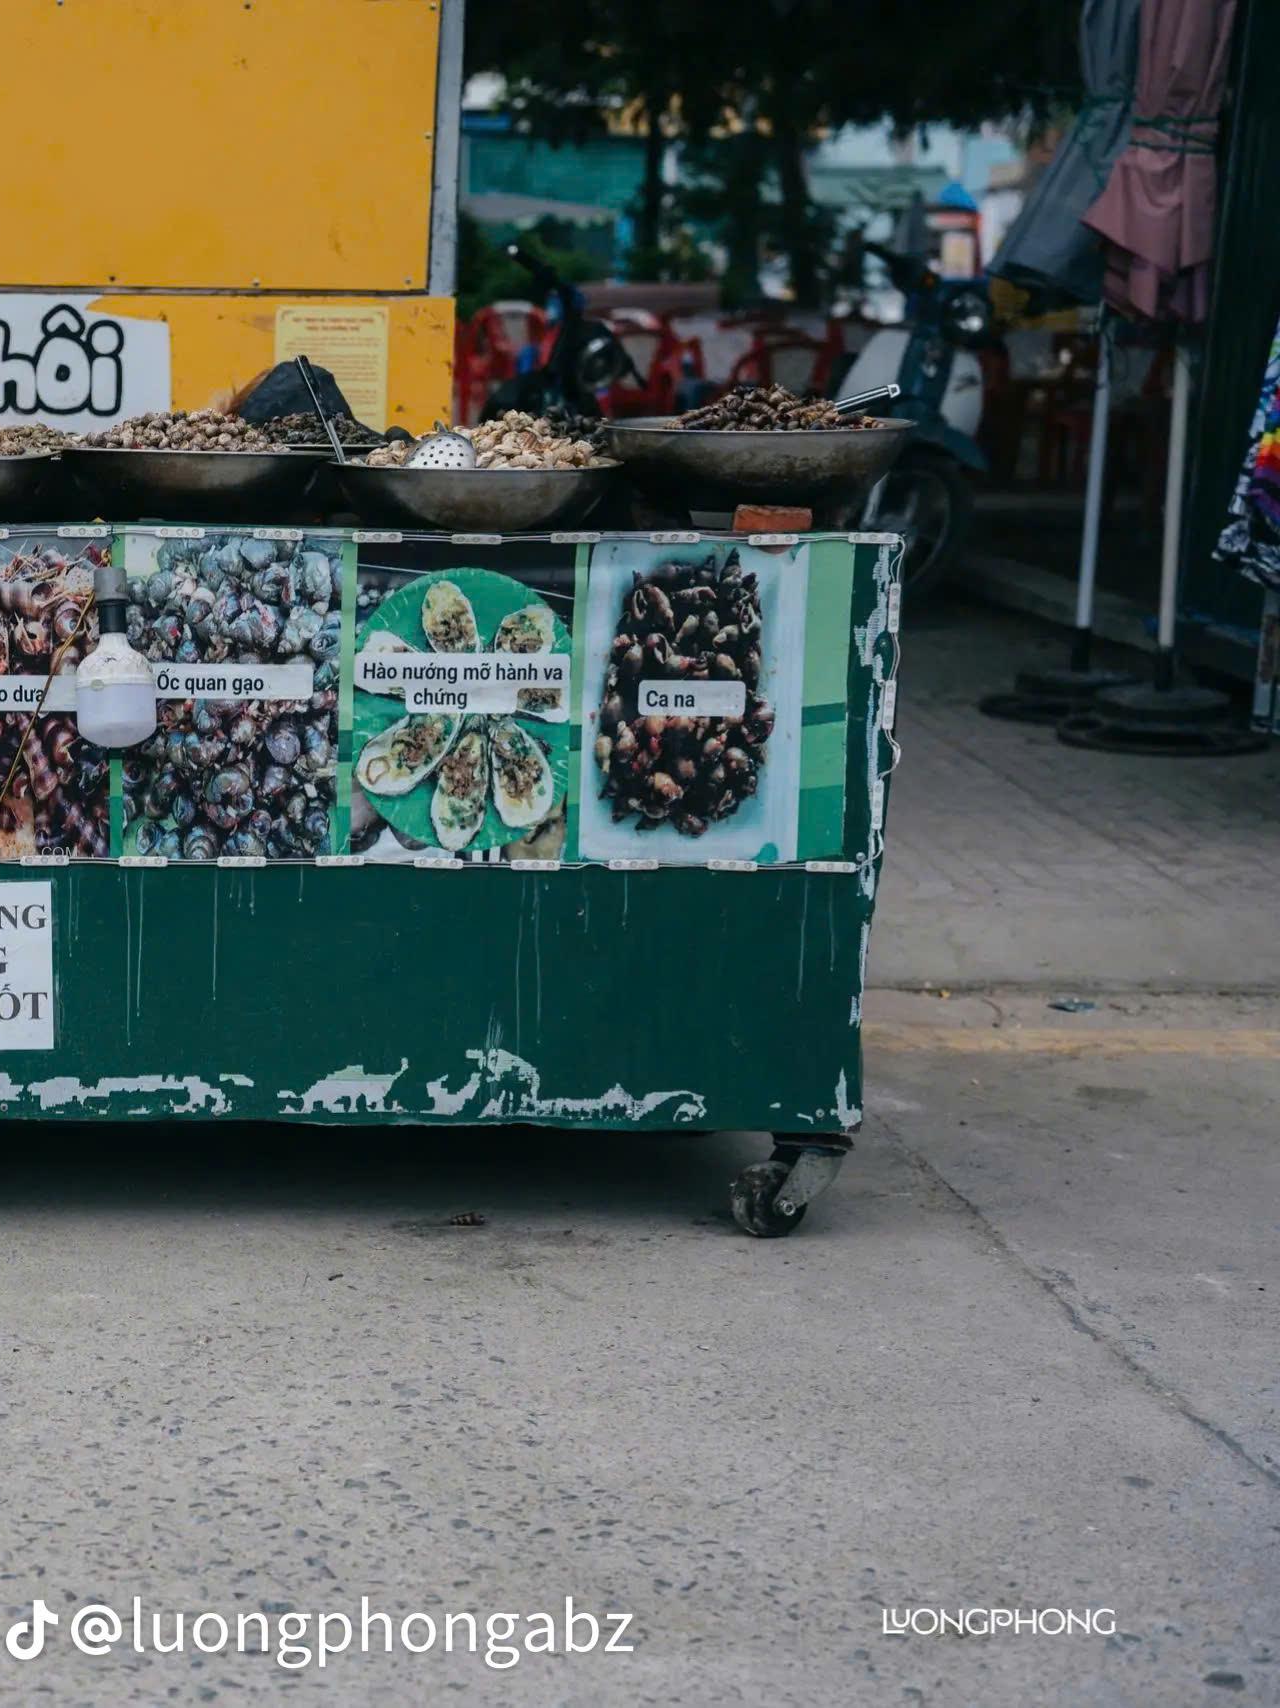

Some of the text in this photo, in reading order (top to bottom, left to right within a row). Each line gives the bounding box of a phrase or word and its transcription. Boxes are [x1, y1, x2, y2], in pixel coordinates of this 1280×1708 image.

[156, 668, 265, 695] Ốc quan gạo
[363, 662, 564, 684] Hào nướng mỡ hành va
[413, 687, 468, 709] chứng
[646, 690, 695, 708] Ca na
